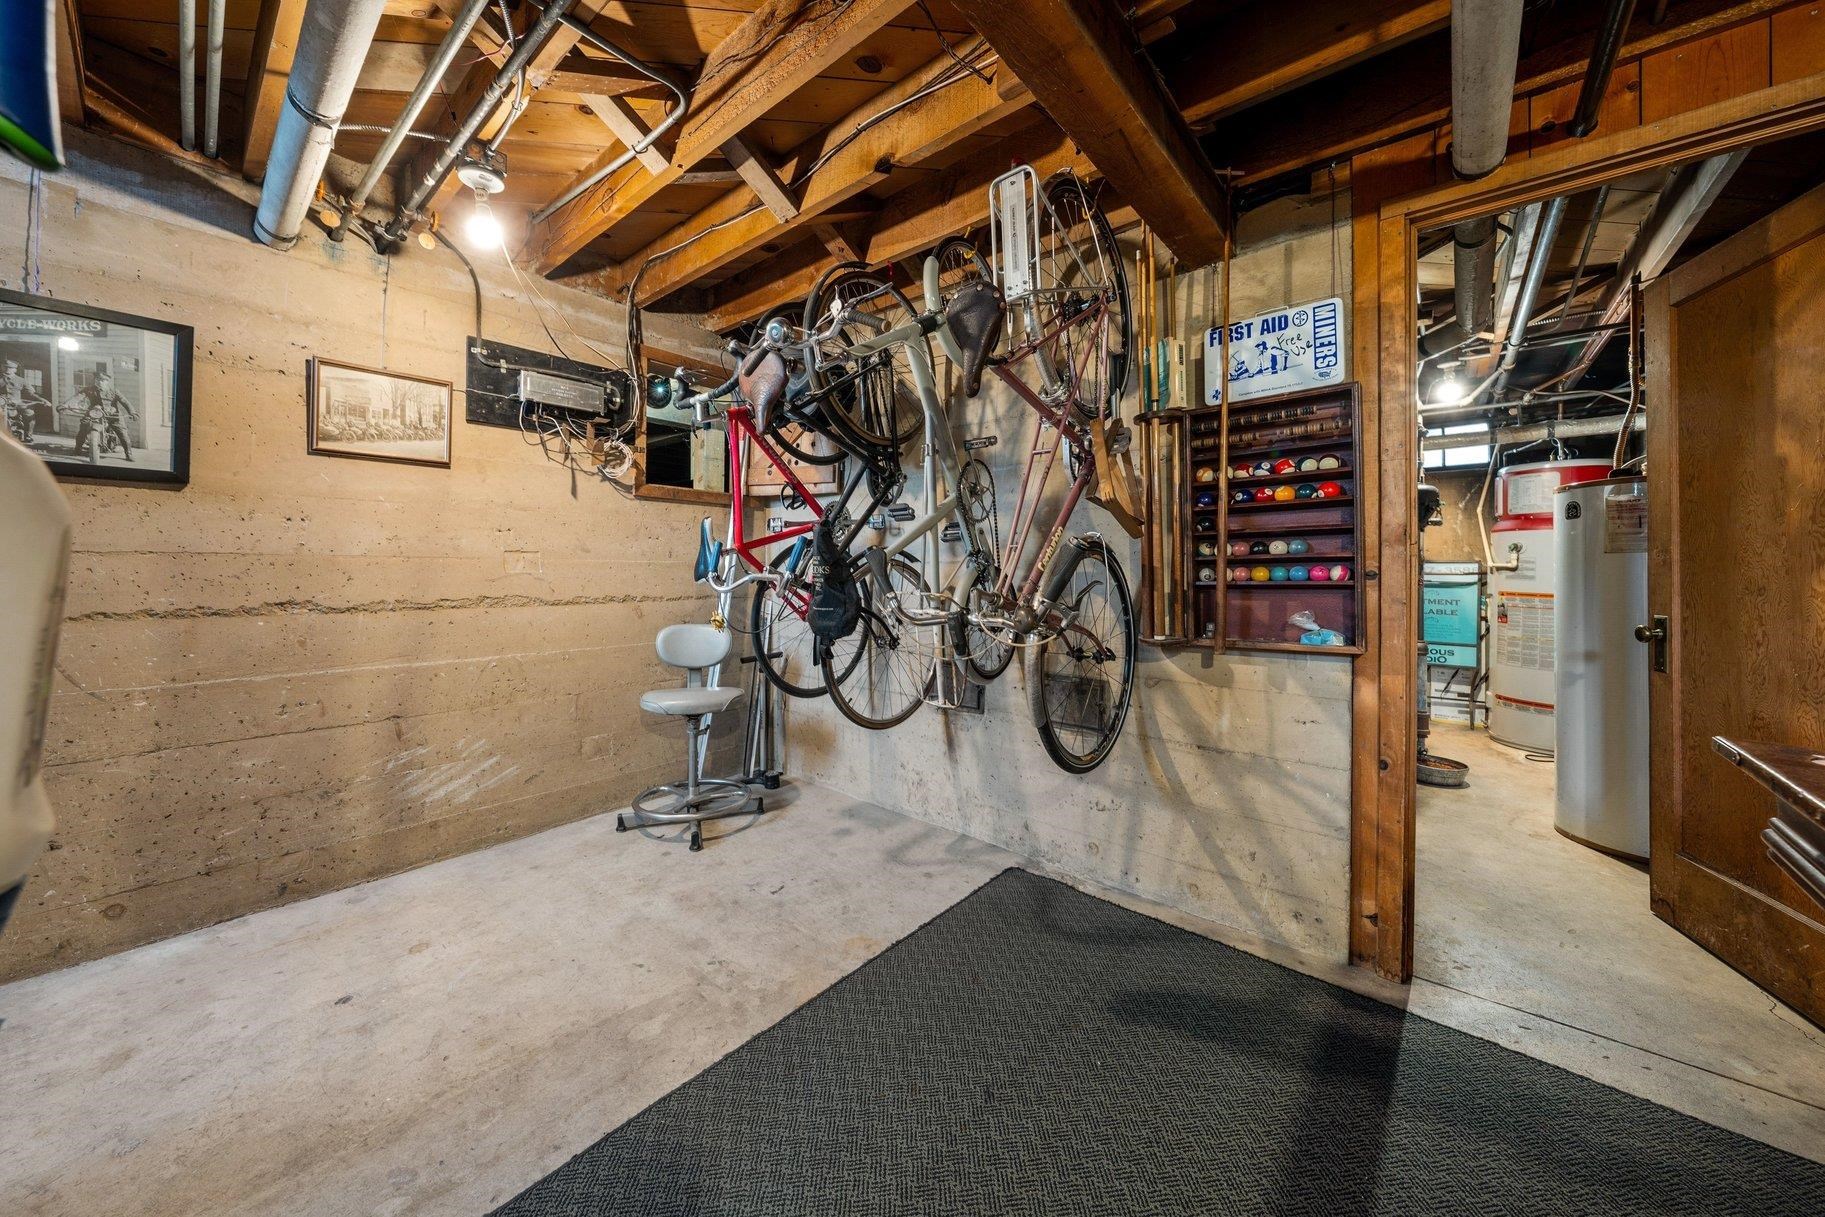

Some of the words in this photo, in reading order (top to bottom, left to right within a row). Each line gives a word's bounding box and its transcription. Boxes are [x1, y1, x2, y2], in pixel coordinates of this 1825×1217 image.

[1260, 314, 1289, 336] AID
[1313, 303, 1337, 369] MINERS
[1277, 333, 1303, 348] Free
[1290, 340, 1314, 357] Use
[1037, 526, 1063, 571] Centurion
